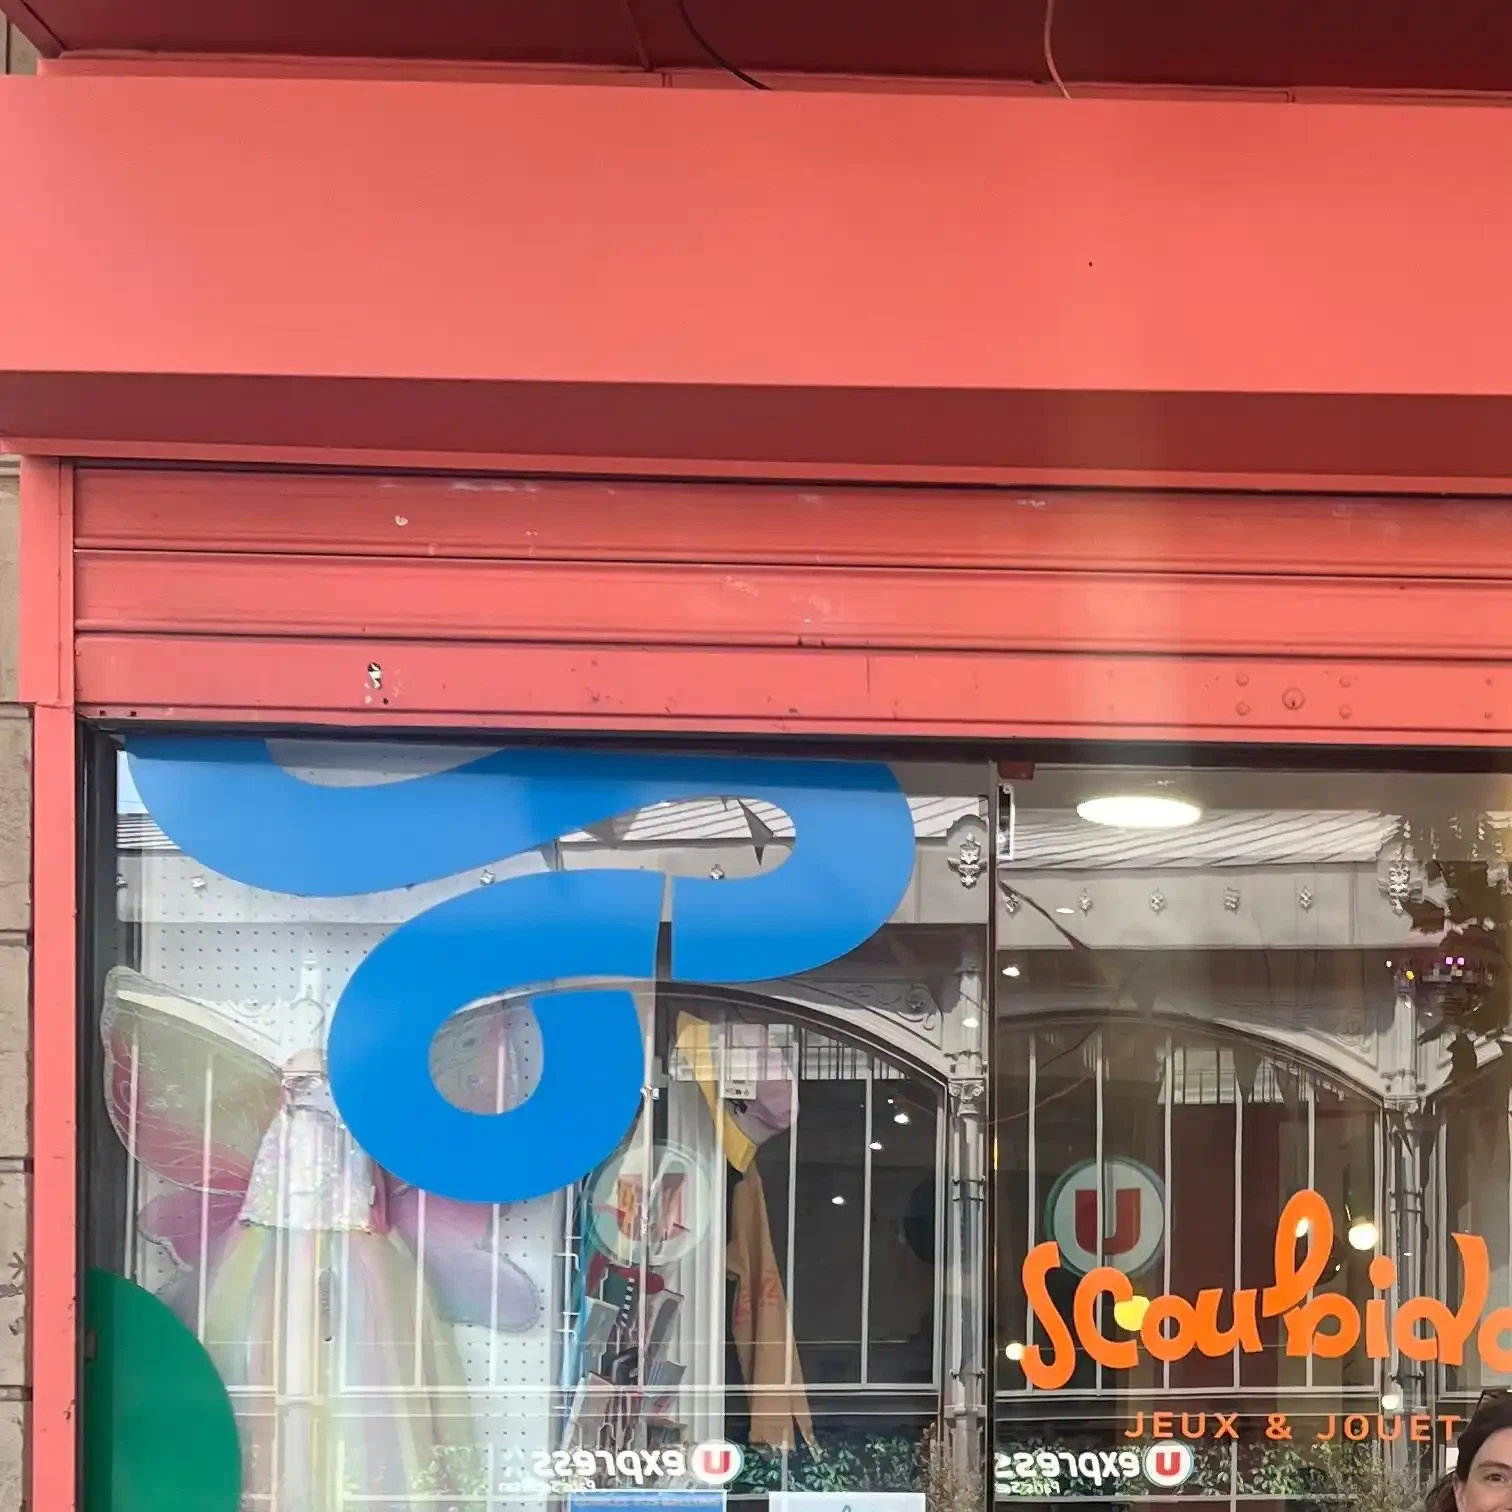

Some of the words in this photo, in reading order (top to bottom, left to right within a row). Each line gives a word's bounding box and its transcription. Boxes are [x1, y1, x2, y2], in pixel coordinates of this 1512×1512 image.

[1124, 1411, 1240, 1439] JEUX
[1265, 1412, 1293, 1440] &
[1316, 1413, 1462, 1441] JOUET
